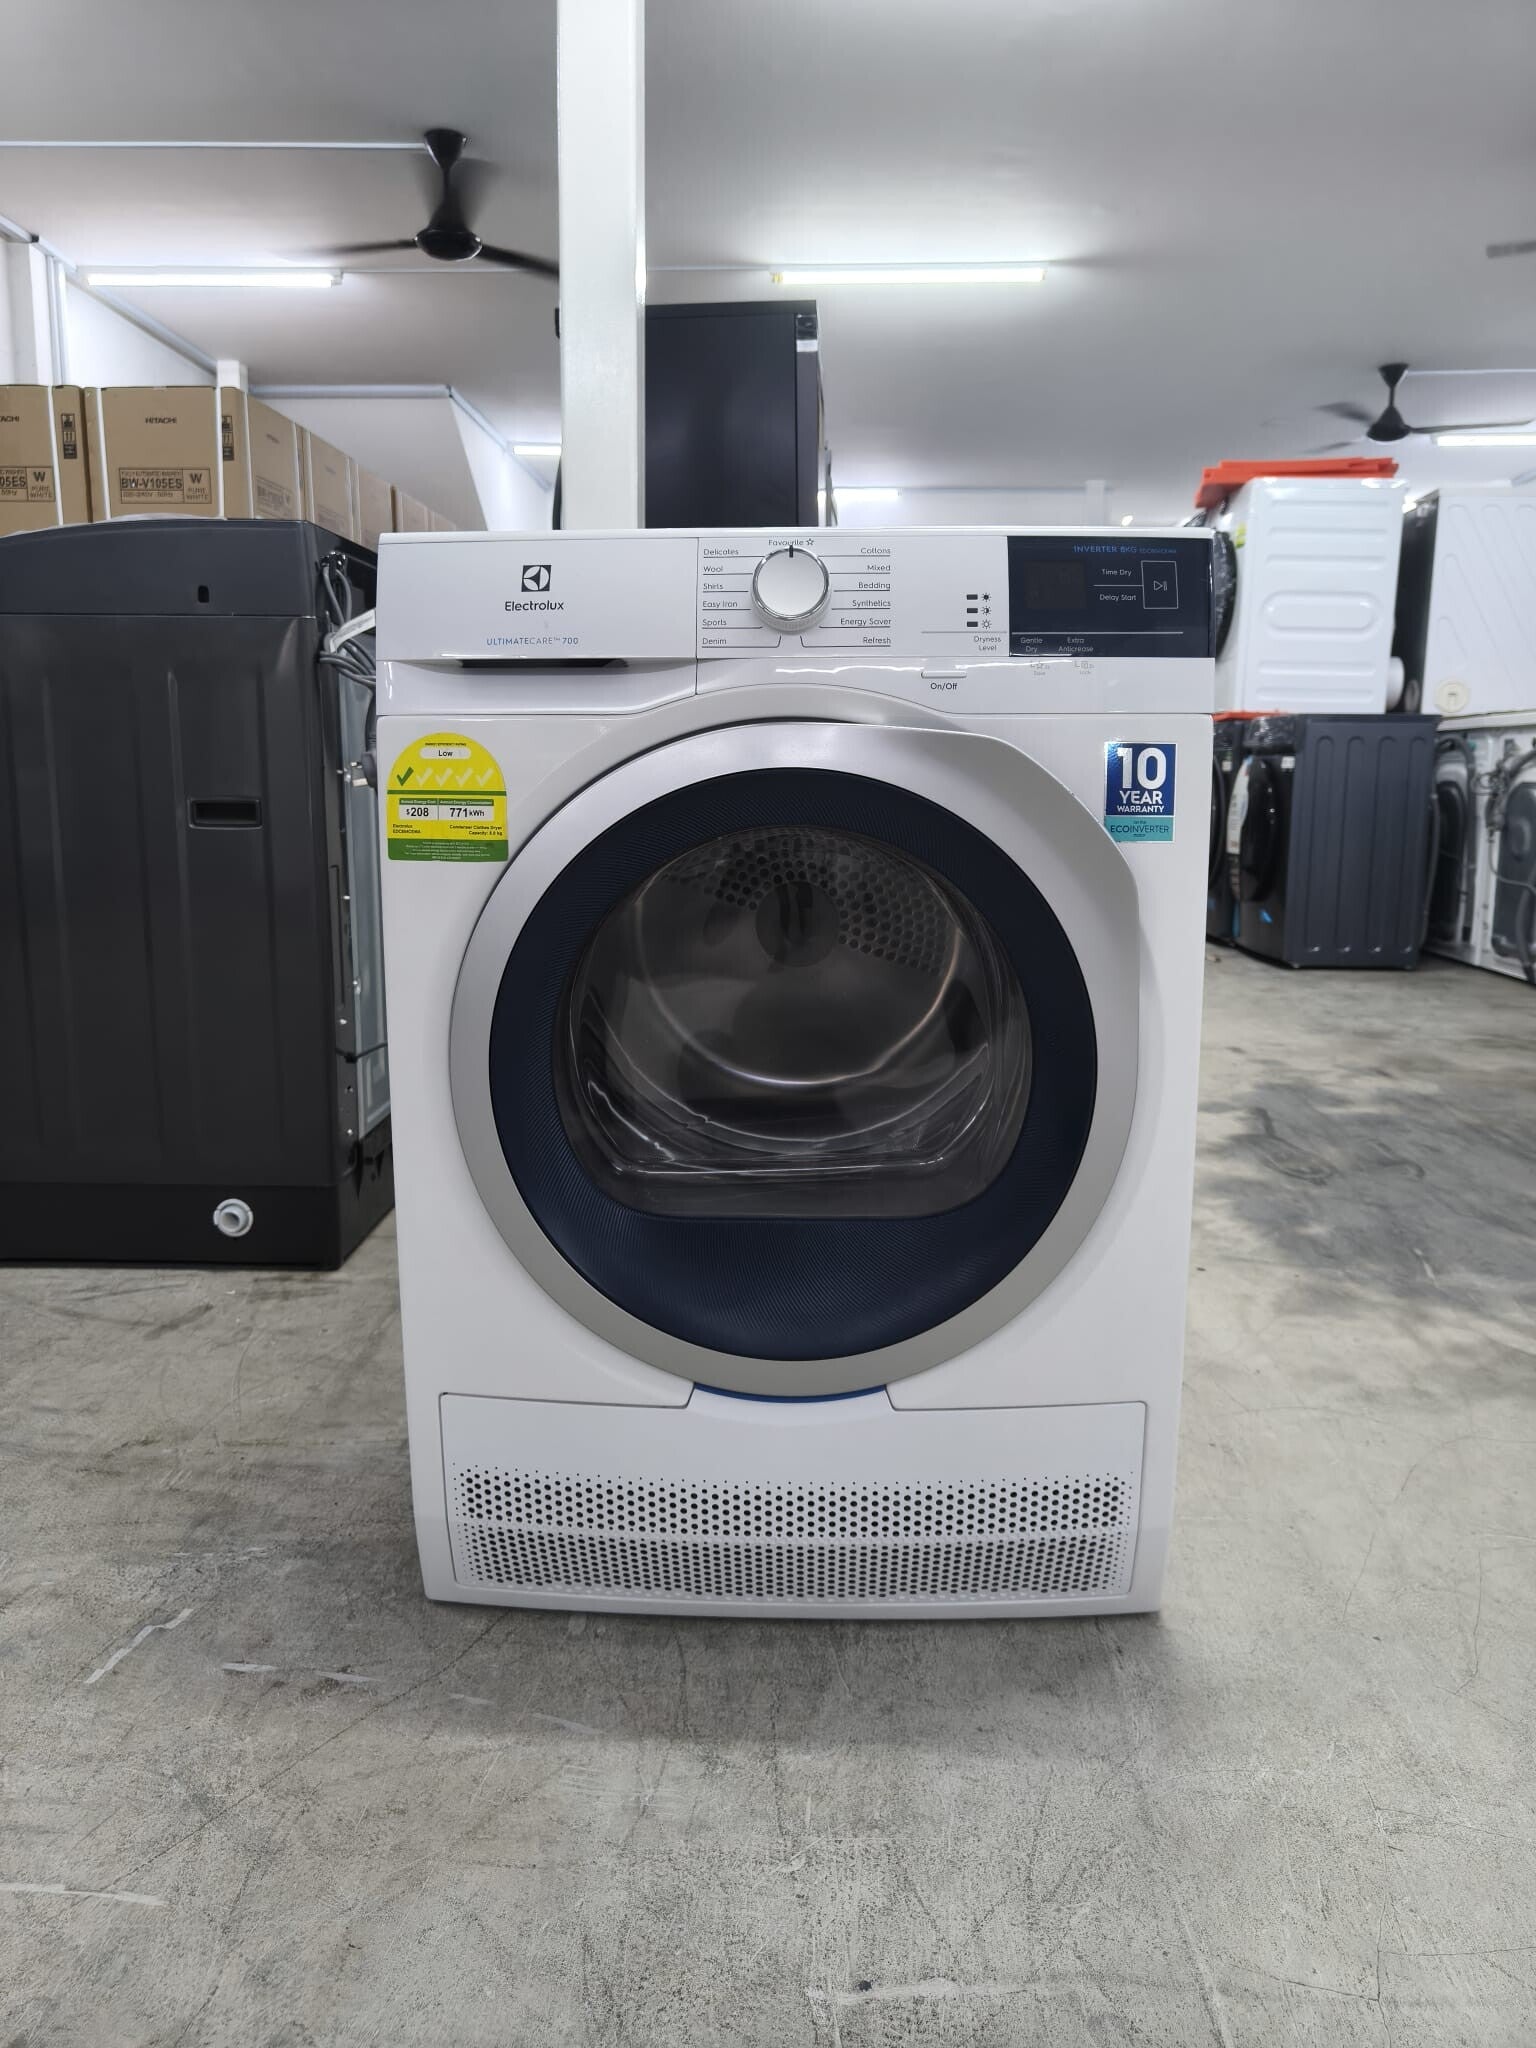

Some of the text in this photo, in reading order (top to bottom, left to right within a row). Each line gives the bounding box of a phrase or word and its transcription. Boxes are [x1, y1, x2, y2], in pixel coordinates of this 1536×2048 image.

[33, 472, 46, 482] W
[190, 473, 202, 484] W
[121, 478, 183, 489] BW-V105ES
[703, 548, 739, 556] Delicates
[860, 547, 891, 555] Cottons
[1073, 545, 1118, 553] INVERTER
[703, 565, 724, 573] Wool
[703, 582, 724, 590] Shirts
[858, 582, 891, 590] Bedding
[1099, 594, 1119, 602] Delay
[504, 600, 564, 611] Electrolux
[702, 601, 721, 609] Easy
[852, 600, 891, 608] Synthetics
[702, 618, 727, 627] Sports
[840, 618, 867, 626] Energy
[562, 637, 579, 645] 700
[1026, 645, 1038, 653] Dry
[930, 682, 958, 691] On/Off
[438, 749, 453, 757] Low
[1117, 747, 1167, 790] 10
[1119, 790, 1163, 805] YEAR
[406, 807, 429, 817] $208
[449, 807, 468, 818] 771
[1117, 805, 1165, 813] WARRANTY
[1110, 825, 1169, 833] ECOINVERTER
